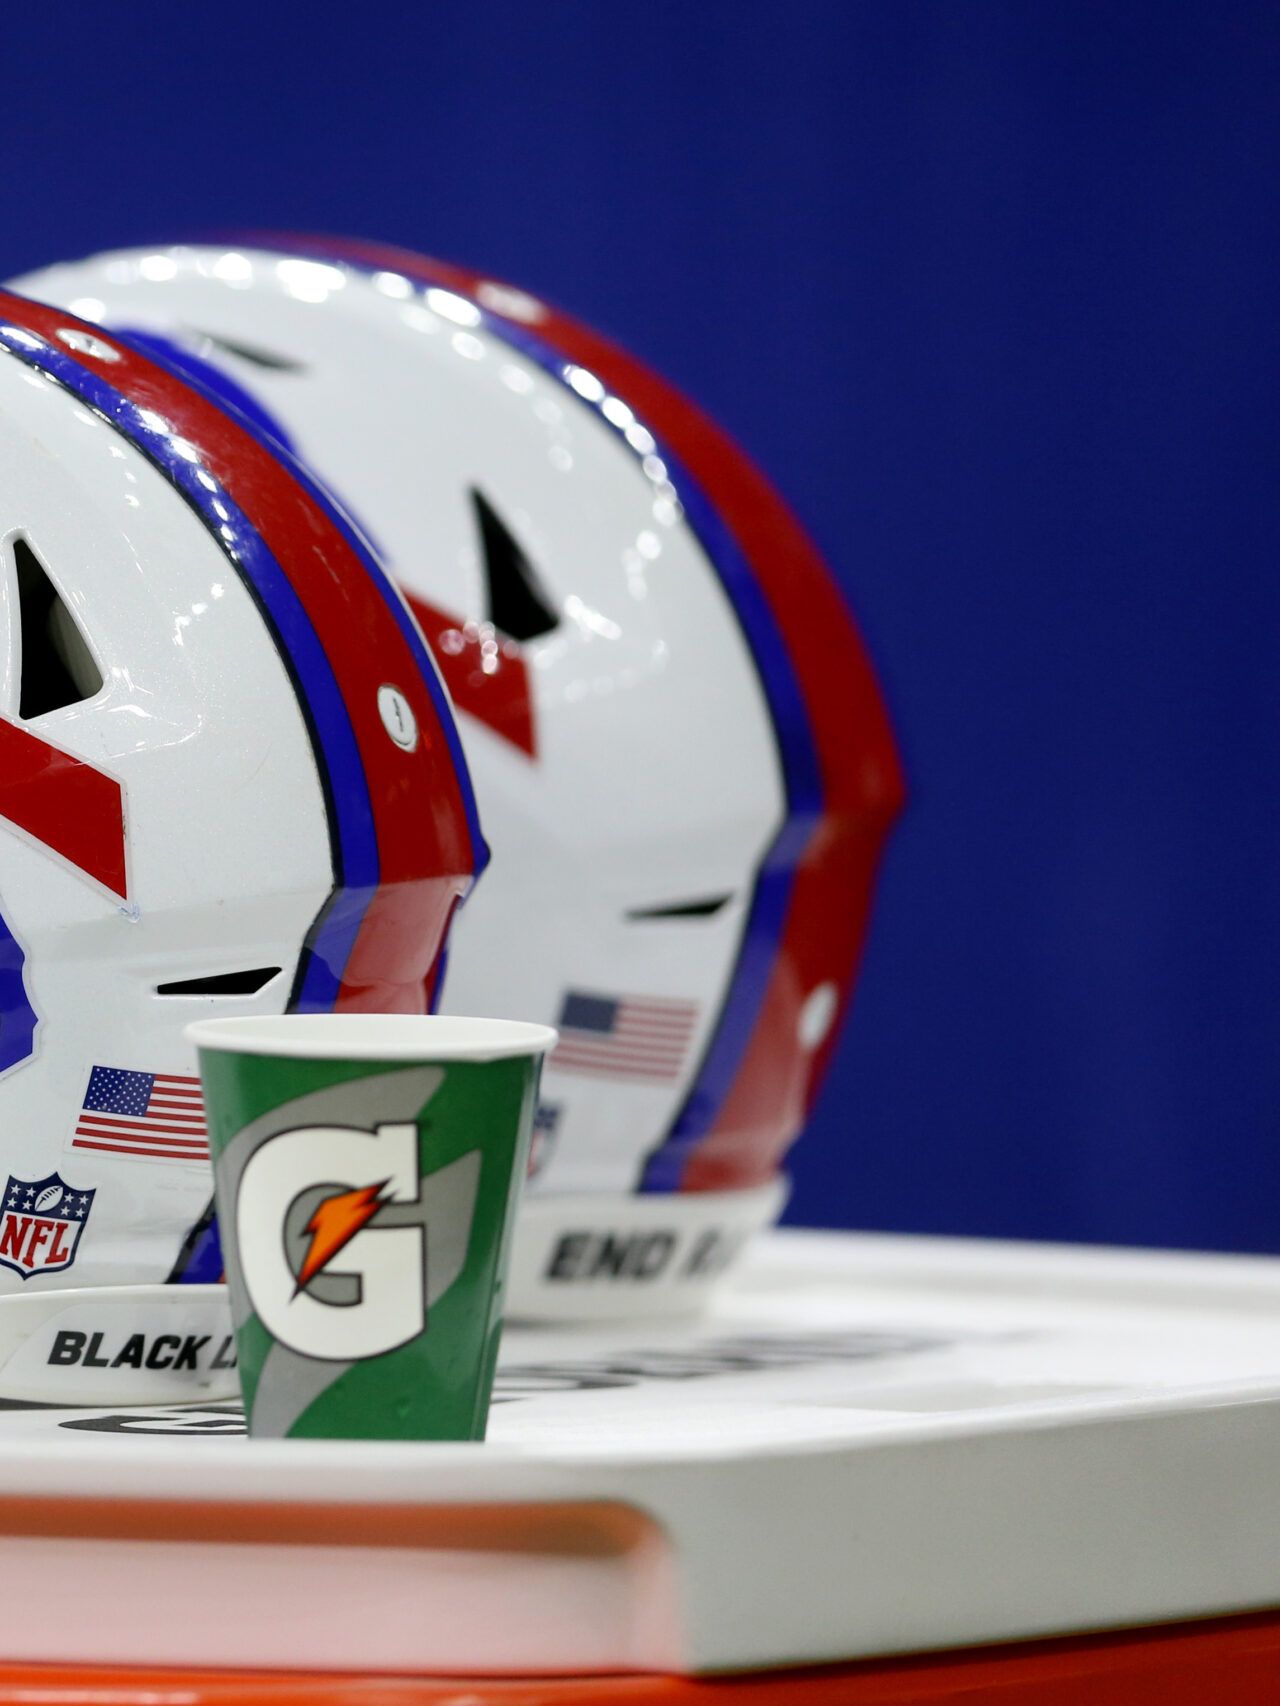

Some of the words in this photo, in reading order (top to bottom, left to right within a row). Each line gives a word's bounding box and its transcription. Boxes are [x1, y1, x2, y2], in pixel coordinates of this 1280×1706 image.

[236, 1120, 427, 1361] G
[545, 1228, 677, 1281] END
[47, 1331, 211, 1369] BLACK
[209, 1335, 237, 1369] L
